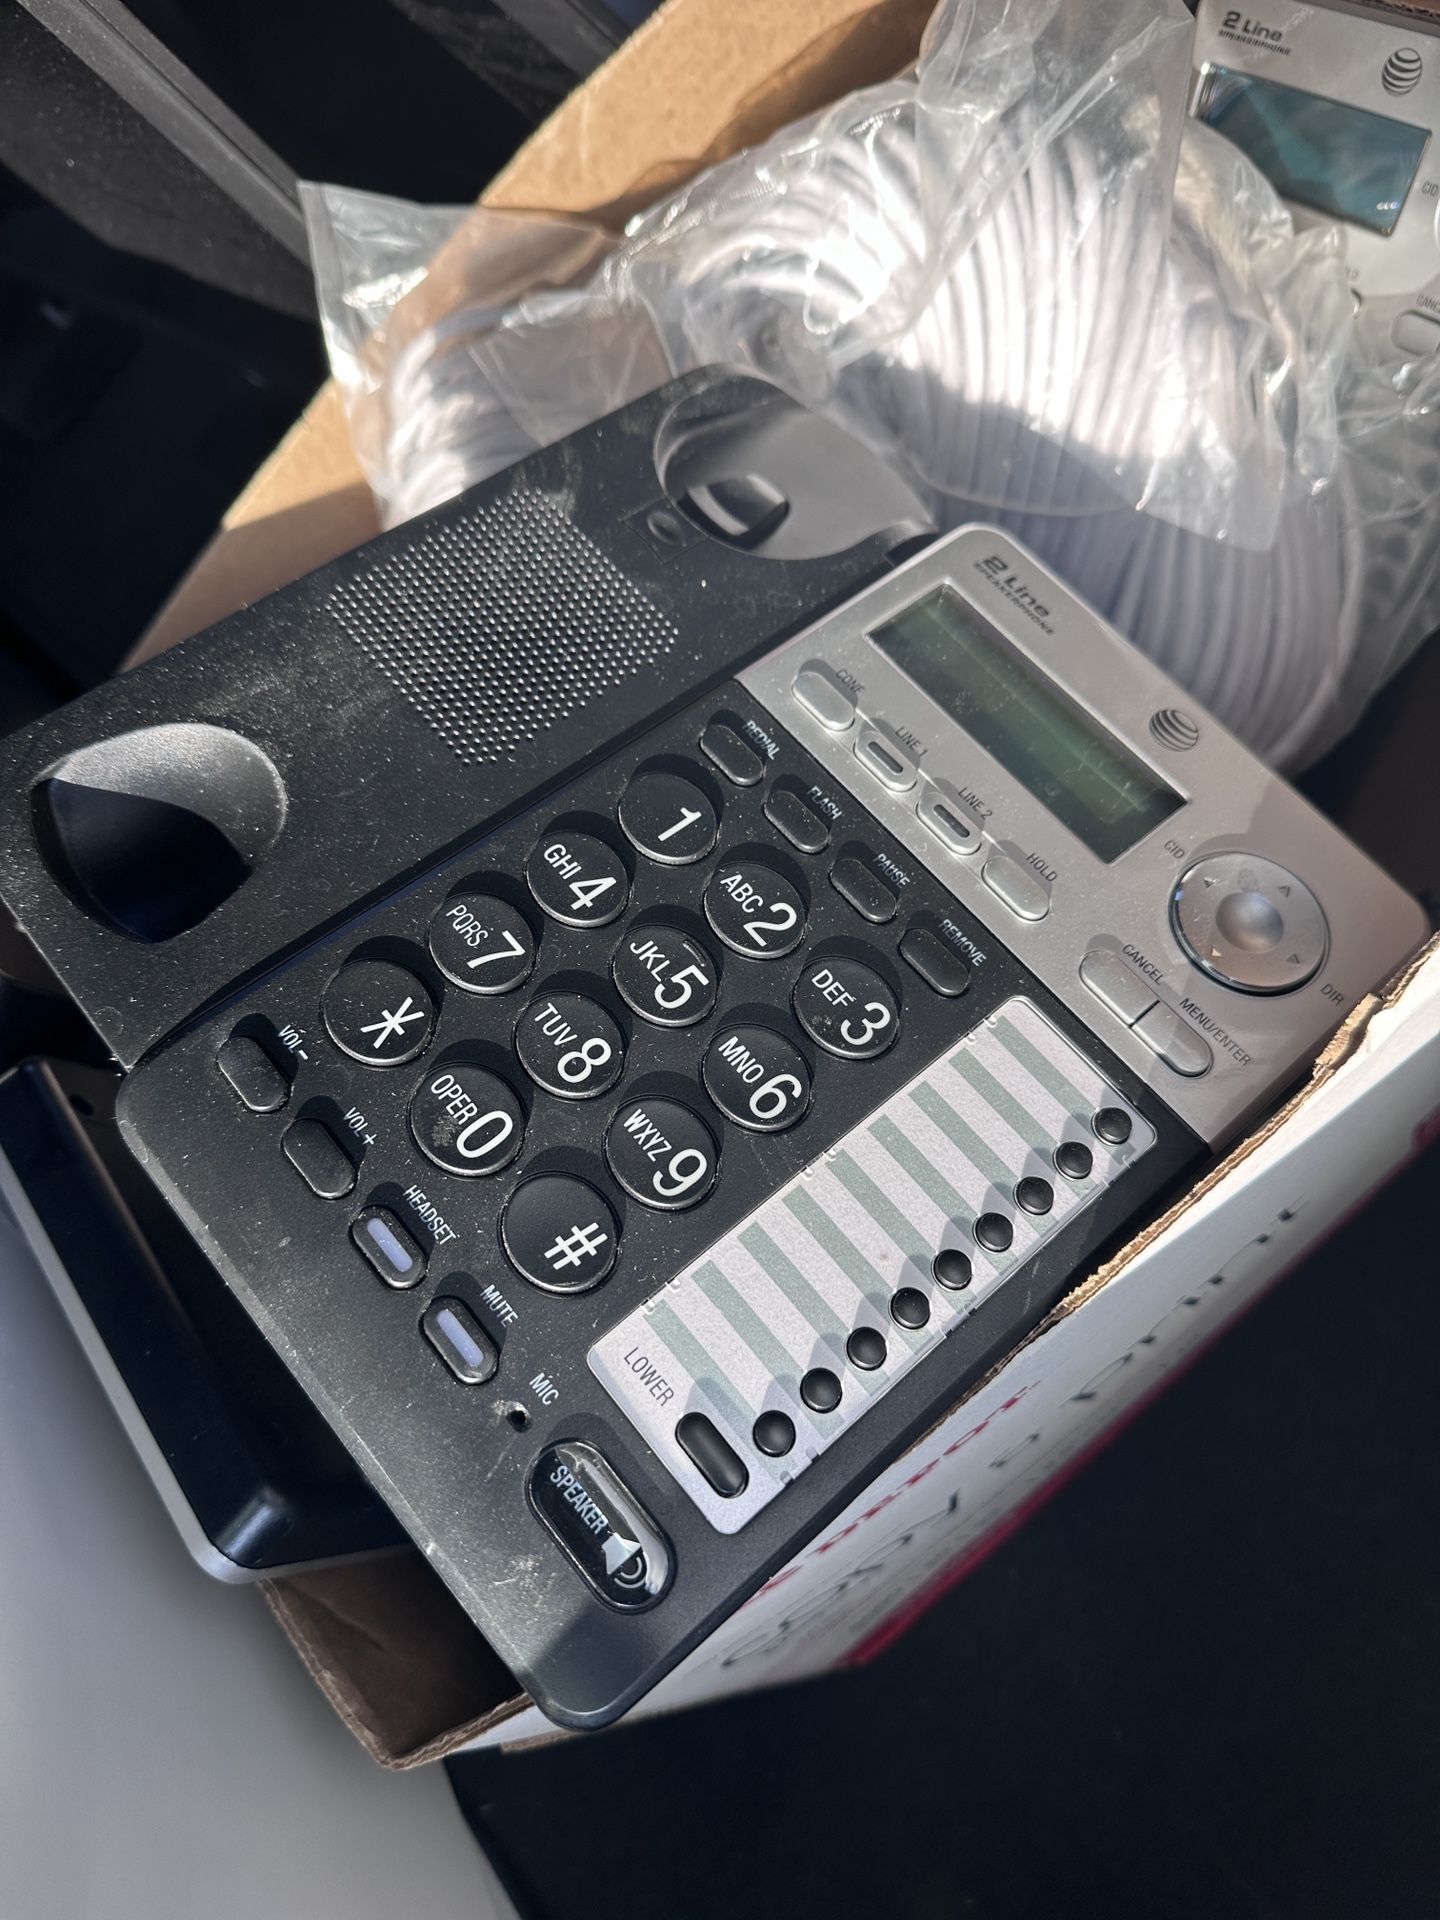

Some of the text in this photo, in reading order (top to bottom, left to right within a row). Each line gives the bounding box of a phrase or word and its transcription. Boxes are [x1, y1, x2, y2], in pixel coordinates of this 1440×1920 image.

[1222, 11, 1283, 42] 2 Line
[1421, 181, 1439, 198] CID
[982, 555, 1050, 618] 2 Line
[835, 669, 866, 694] CONF
[744, 719, 781, 761] REDIAL
[895, 726, 929, 759] LINE 1
[657, 806, 702, 841] 1
[806, 784, 843, 820] FLASH
[957, 785, 993, 821] LINE 2
[873, 852, 911, 890] PAUSE
[1025, 851, 1059, 883] HOLD
[1163, 837, 1186, 862] CID
[543, 843, 617, 911] GHI 4
[720, 872, 797, 947] ABC 2
[445, 904, 526, 969] PQRS 7
[938, 918, 988, 967] REMOVE
[629, 940, 709, 1009] JKL 5
[1121, 942, 1167, 985] CANCEL
[811, 968, 891, 1045] DEF 3
[1319, 982, 1346, 1009] DIR
[534, 1002, 612, 1084] TUV 8
[1179, 996, 1253, 1068] MENU/ENTER
[718, 1035, 802, 1119] MNO 6
[431, 1074, 513, 1158] OPER 0
[623, 1108, 708, 1197] WXYZ 9
[404, 1184, 458, 1246] HEADSET
[543, 1221, 608, 1271] #
[480, 1284, 519, 1328] MUTE
[529, 1372, 560, 1406] MIC
[623, 1346, 676, 1408] LOWER
[549, 1464, 610, 1535] SPEAKER
